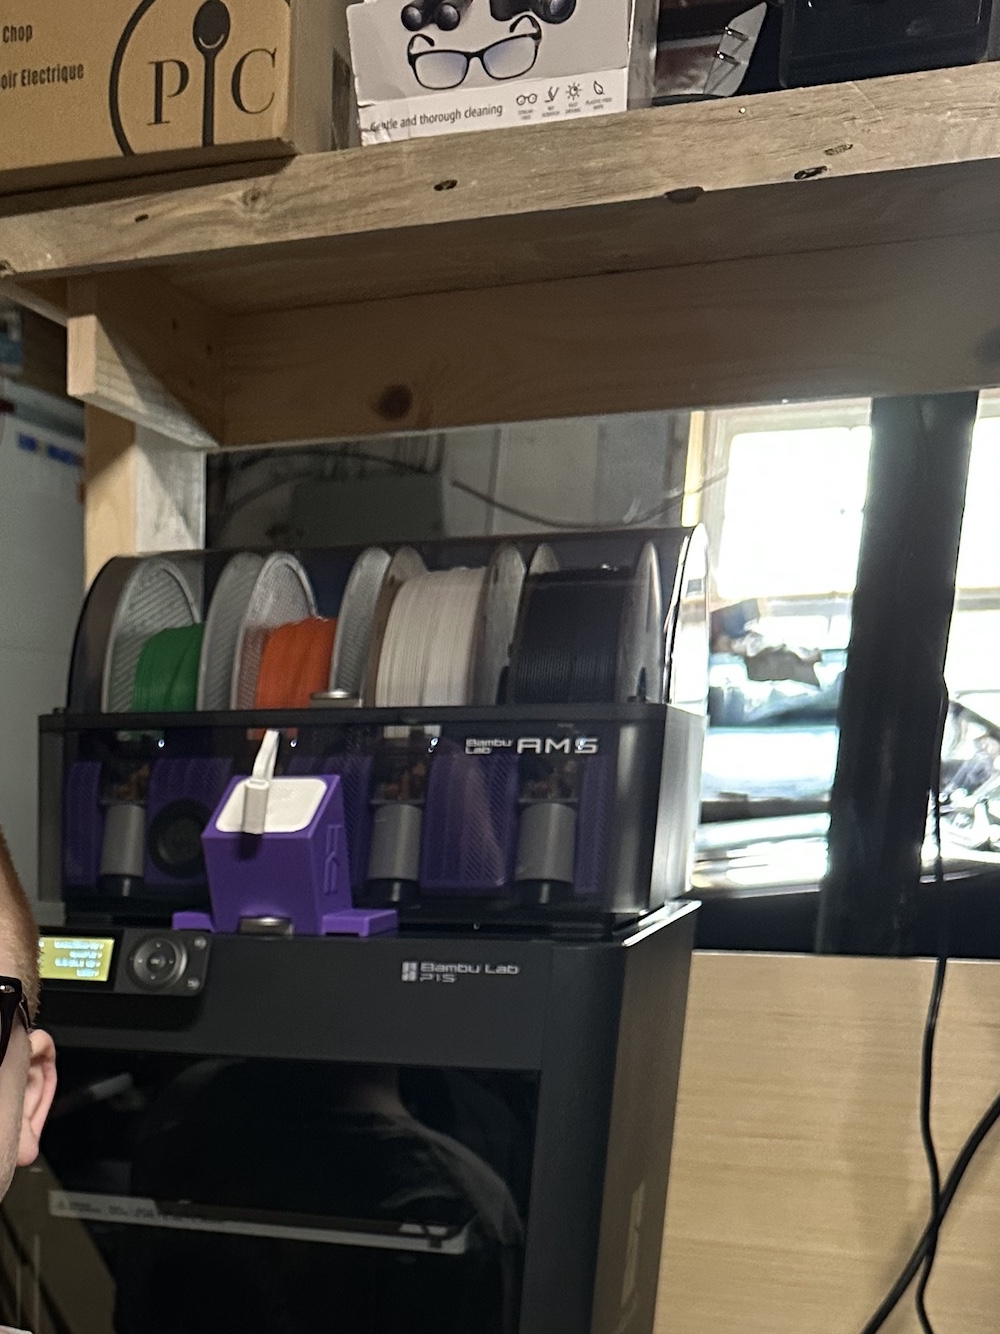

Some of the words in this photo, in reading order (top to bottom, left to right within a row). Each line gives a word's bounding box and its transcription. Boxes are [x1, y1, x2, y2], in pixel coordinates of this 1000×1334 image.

[2, 24, 33, 43] Chop
[20, 62, 85, 87] Electrique
[369, 118, 398, 132] Gentle
[400, 115, 417, 129] and
[419, 110, 462, 128] thorough
[464, 104, 503, 119] cleaning
[465, 738, 514, 747] Bambu
[516, 737, 599, 754] AMS
[420, 962, 481, 974] Bambu
[484, 964, 520, 975] Lab
[420, 973, 457, 983] P1S
